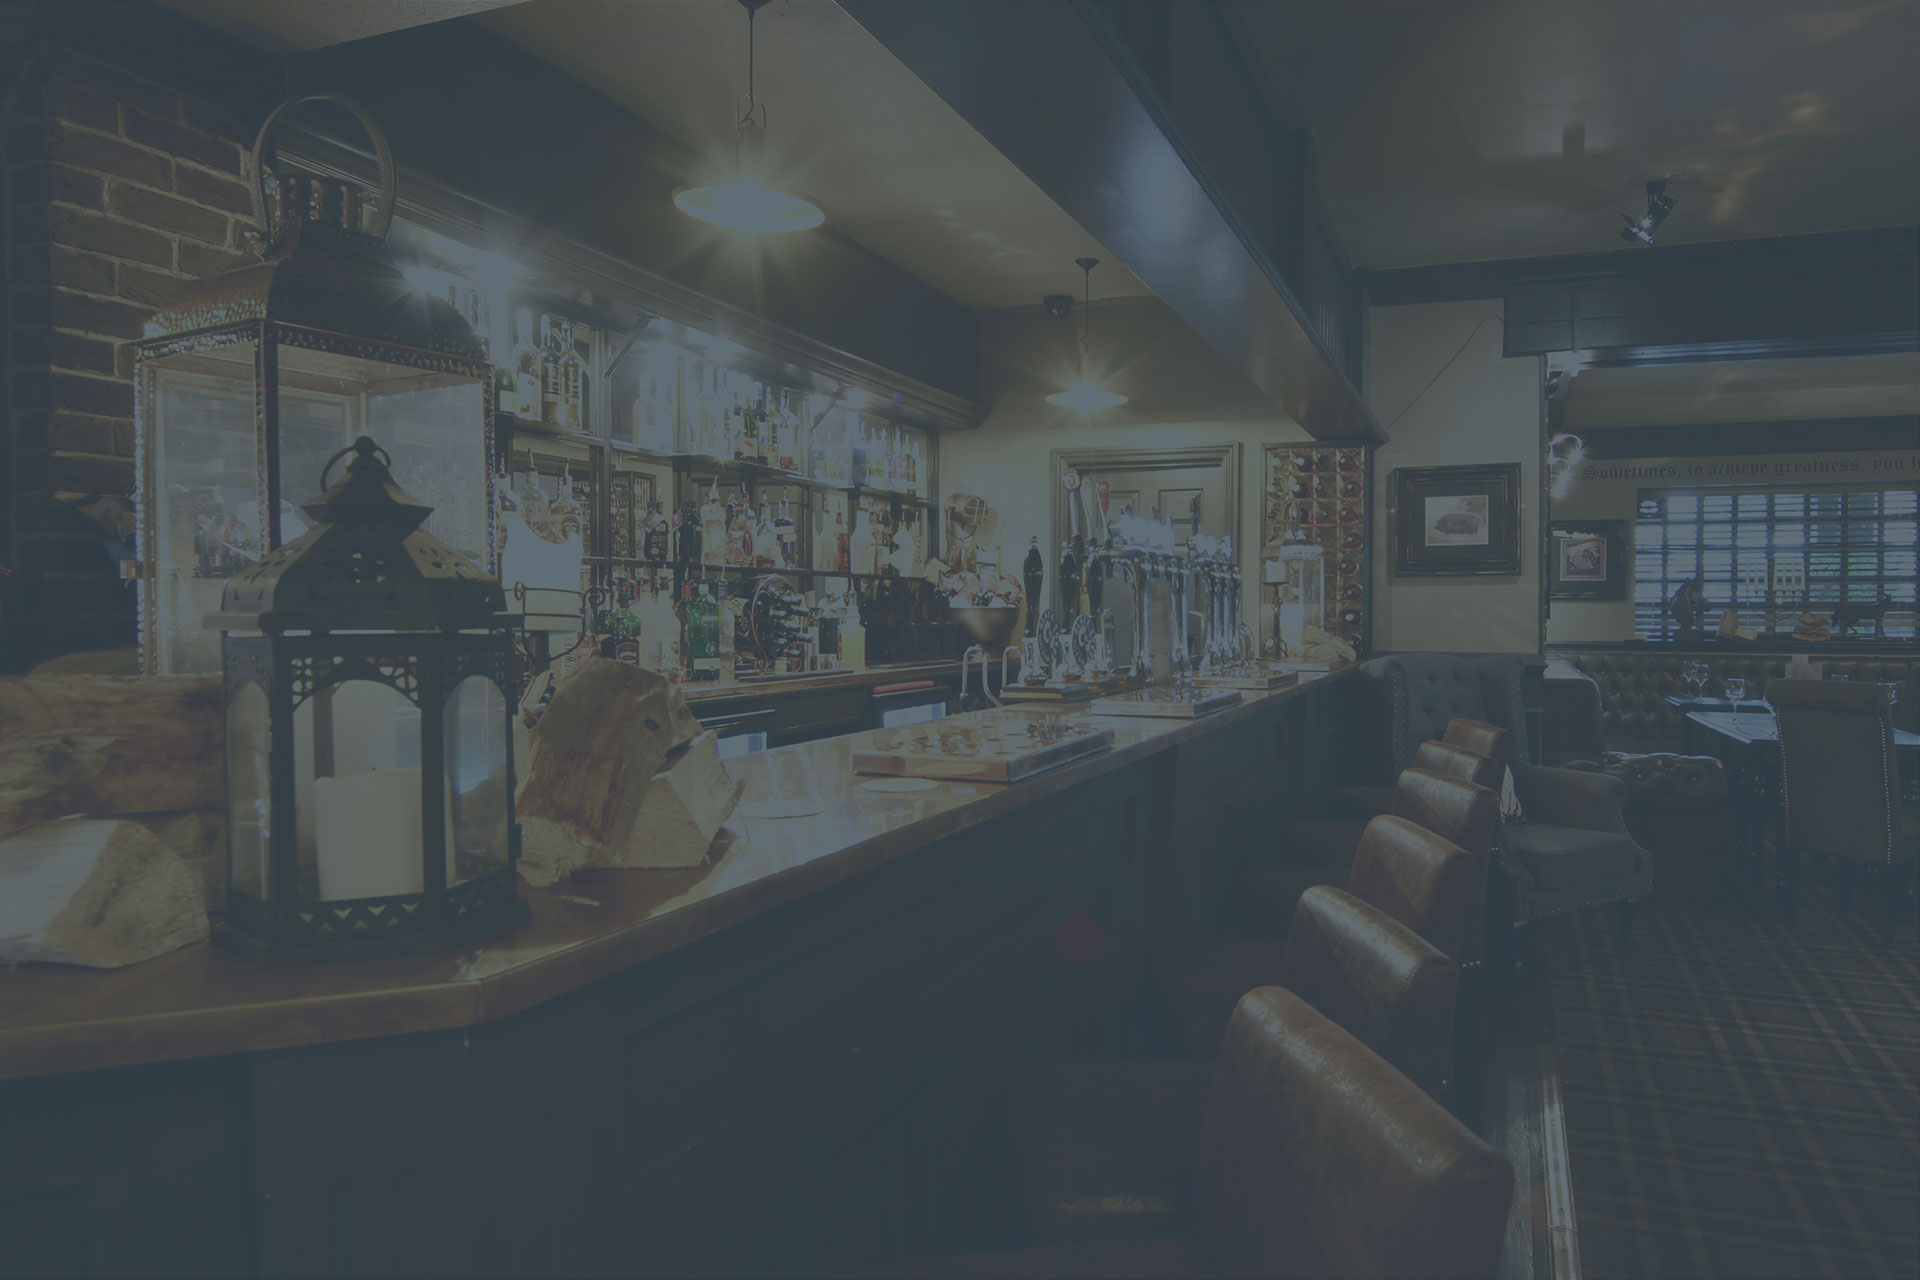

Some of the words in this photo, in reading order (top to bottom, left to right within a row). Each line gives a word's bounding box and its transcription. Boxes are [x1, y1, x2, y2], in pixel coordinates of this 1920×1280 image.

[1583, 464, 1681, 480] Sometimes,
[1687, 462, 1705, 477] to
[1708, 460, 1768, 477] achieve
[1774, 458, 1866, 477] greatness,
[1872, 458, 1905, 473] you
